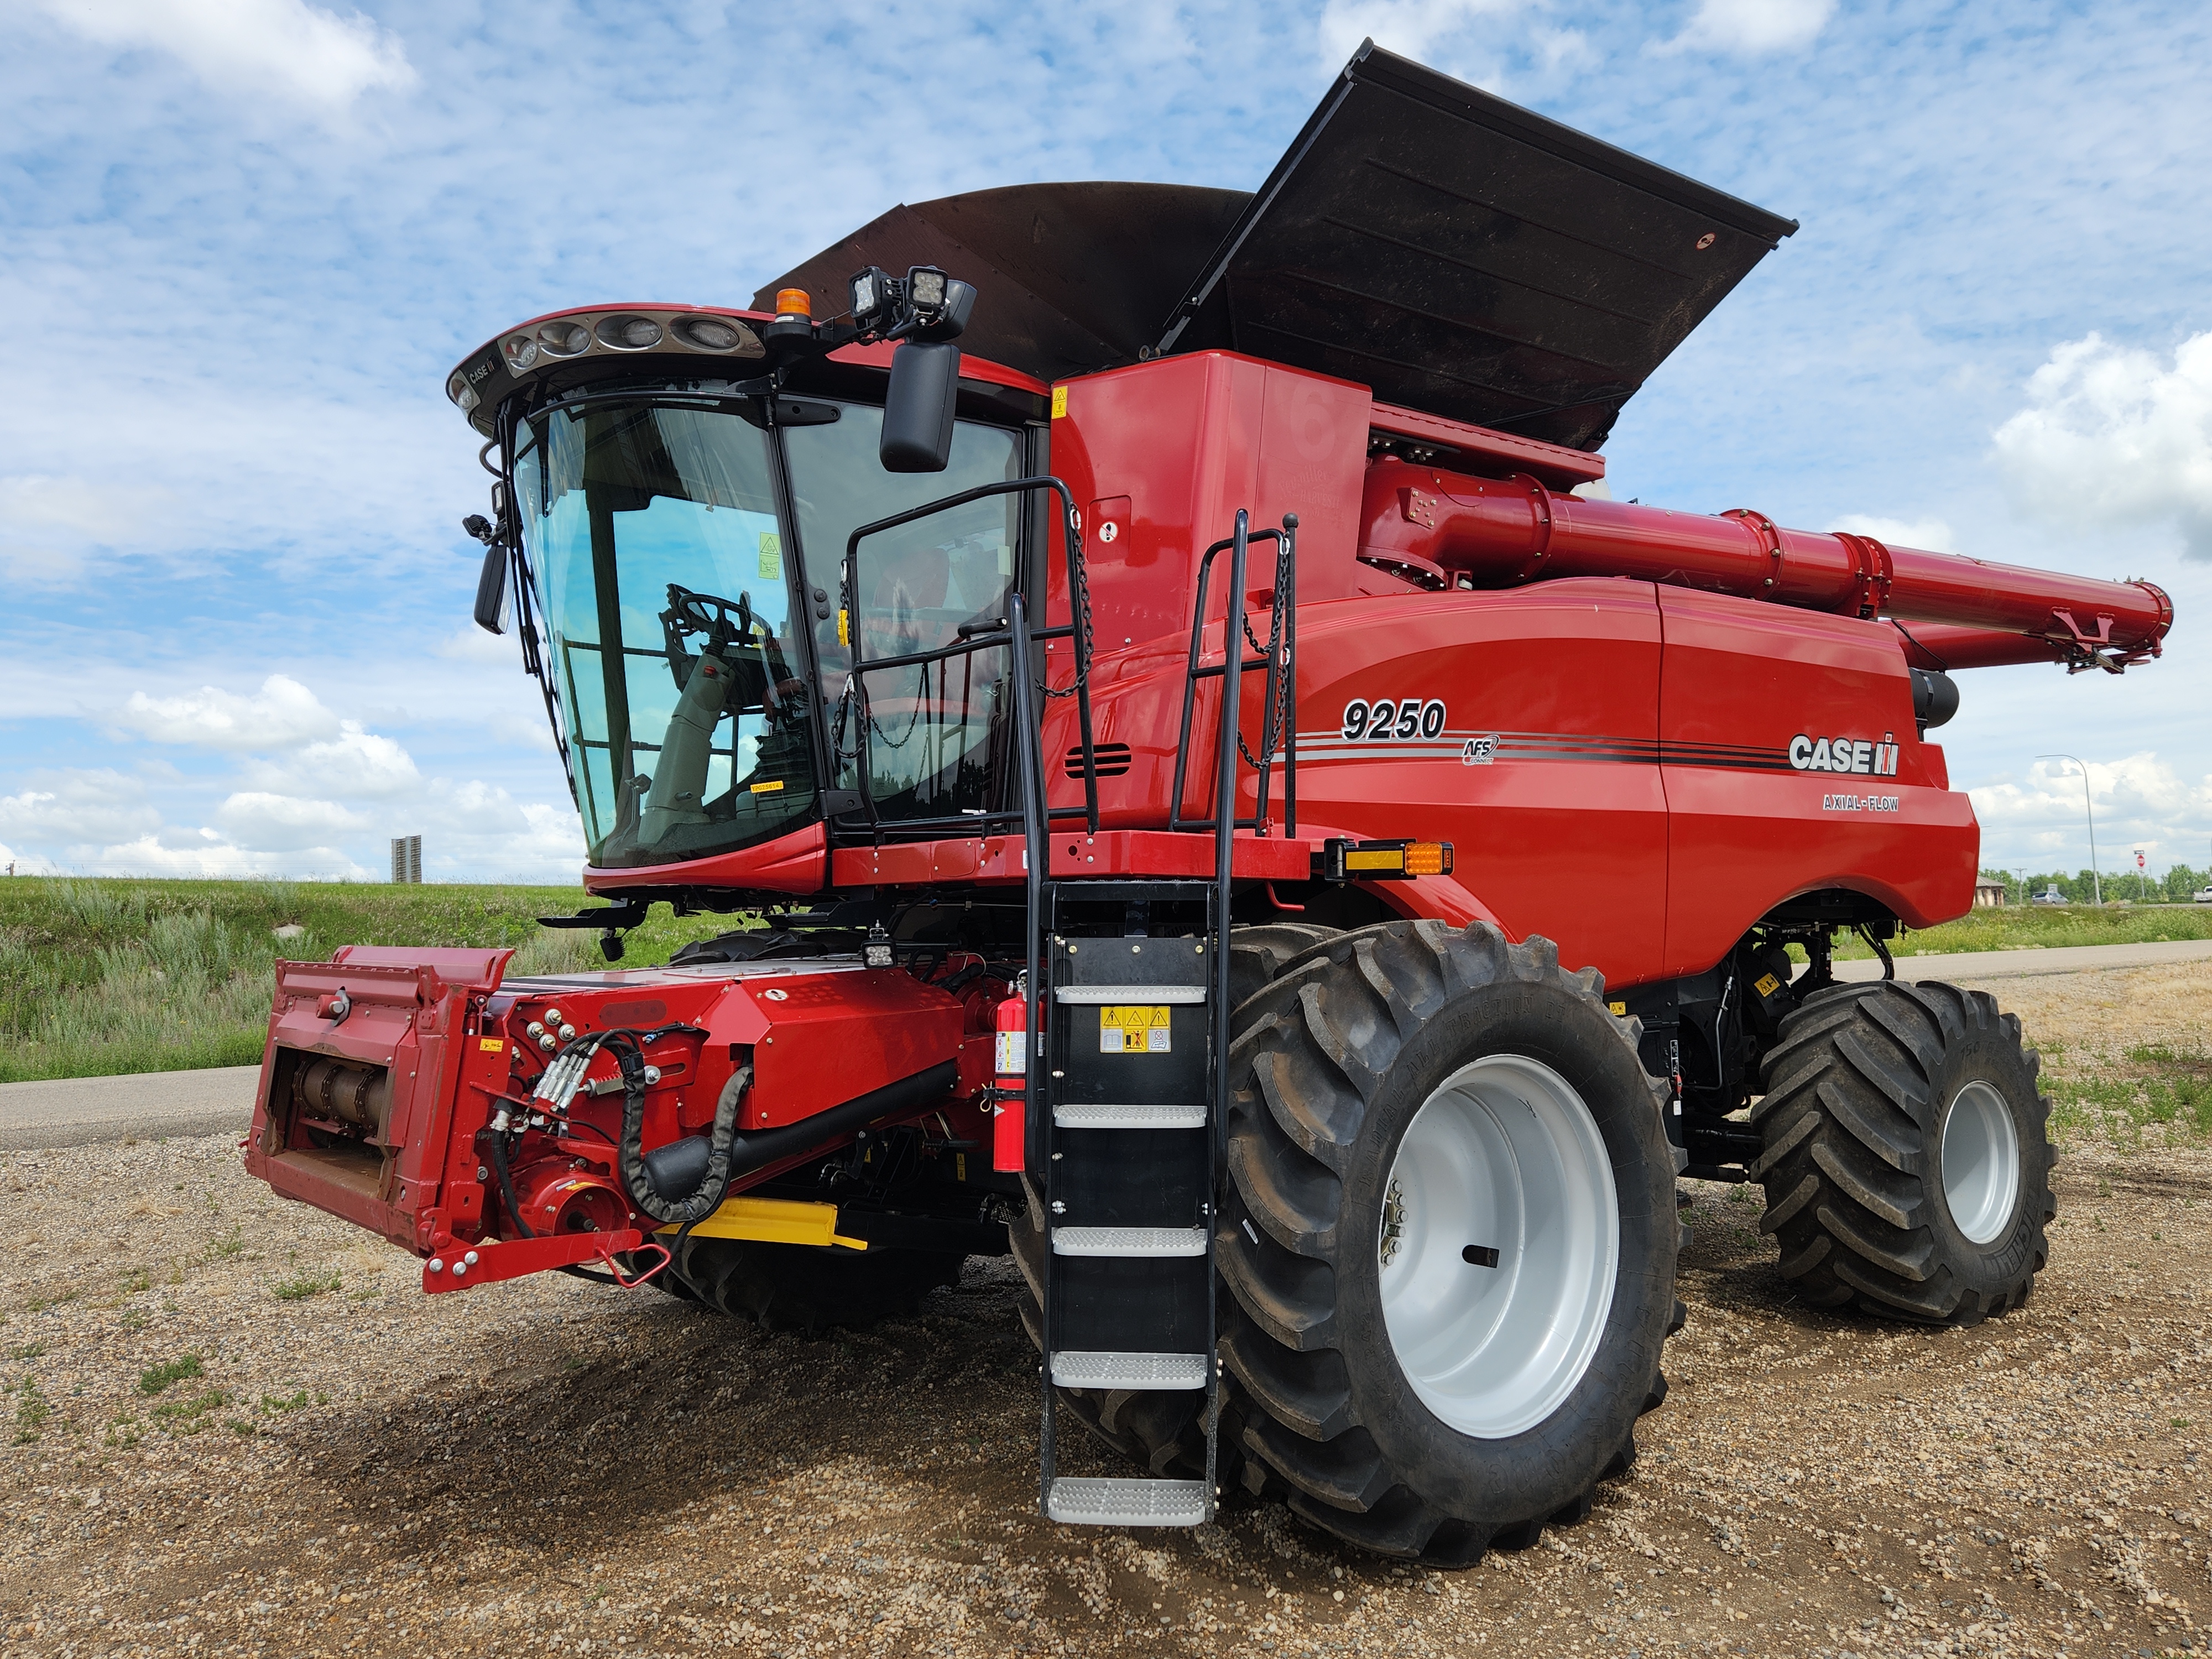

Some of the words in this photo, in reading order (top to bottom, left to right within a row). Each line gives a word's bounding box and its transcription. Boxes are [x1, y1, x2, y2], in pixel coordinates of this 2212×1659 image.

[469, 365, 488, 384] CASE
[1341, 698, 1446, 742] 9250
[1463, 740, 1492, 756] AFS
[1790, 735, 1871, 773] CASE
[1823, 795, 1899, 811] AXIAL-FLOW
[1359, 1089, 1405, 1187] RADIAL
[1407, 1038, 1440, 1078] ALL
[1446, 995, 1535, 1037] TRACTION
